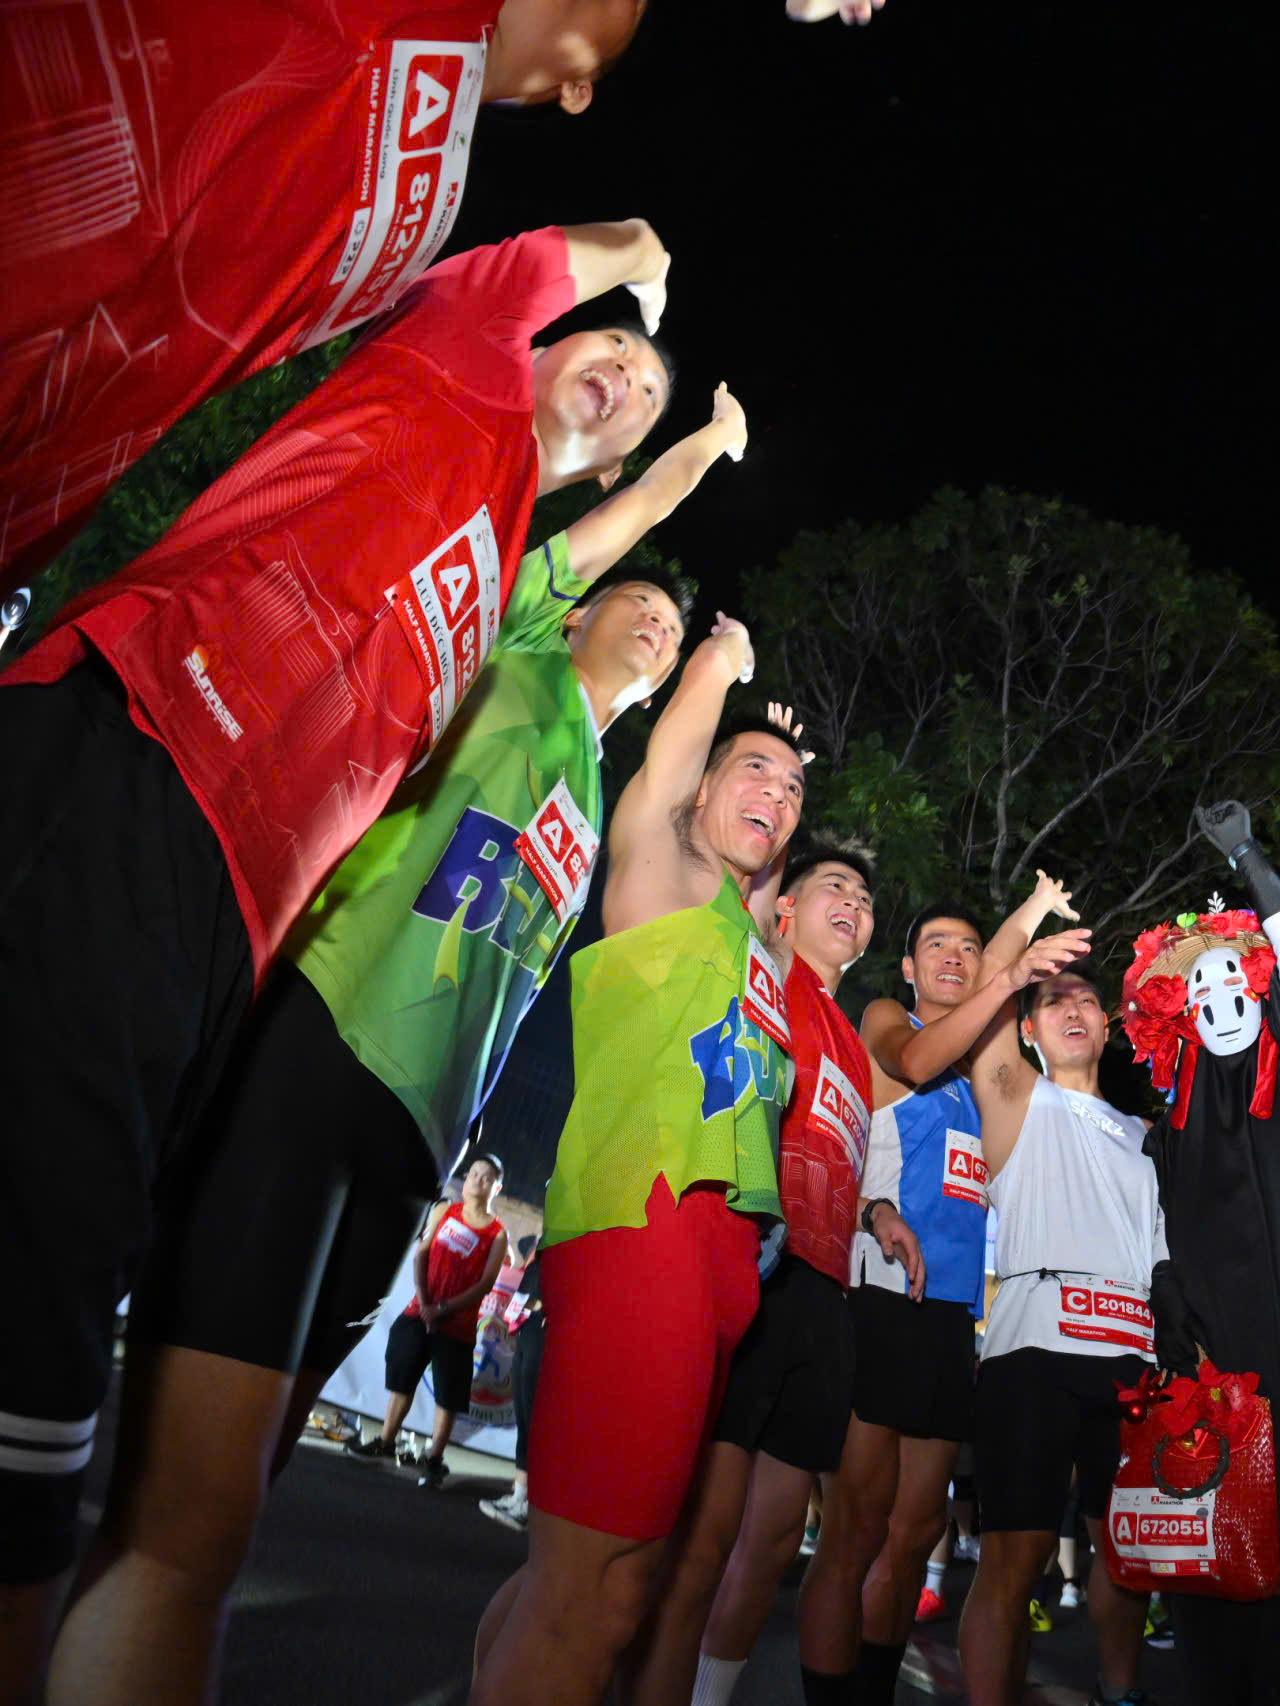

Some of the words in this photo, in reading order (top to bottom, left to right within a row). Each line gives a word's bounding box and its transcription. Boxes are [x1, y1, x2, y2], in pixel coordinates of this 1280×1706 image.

[368, 67, 381, 107] HALF
[407, 69, 451, 137] A
[360, 112, 378, 201] MARATHON
[439, 564, 471, 617] A
[403, 599, 419, 627] HALF
[415, 628, 437, 686] MARATHON
[541, 819, 564, 856] A
[525, 847, 538, 867] HALF
[535, 865, 559, 901] MARATHON
[753, 969, 771, 999] A
[824, 1090, 839, 1115] A
[952, 1154, 969, 1174] A
[1067, 1291, 1087, 1311] C
[1098, 1298, 1151, 1320] 201844
[1117, 1516, 1132, 1540] A
[1140, 1520, 1205, 1536] 672055
